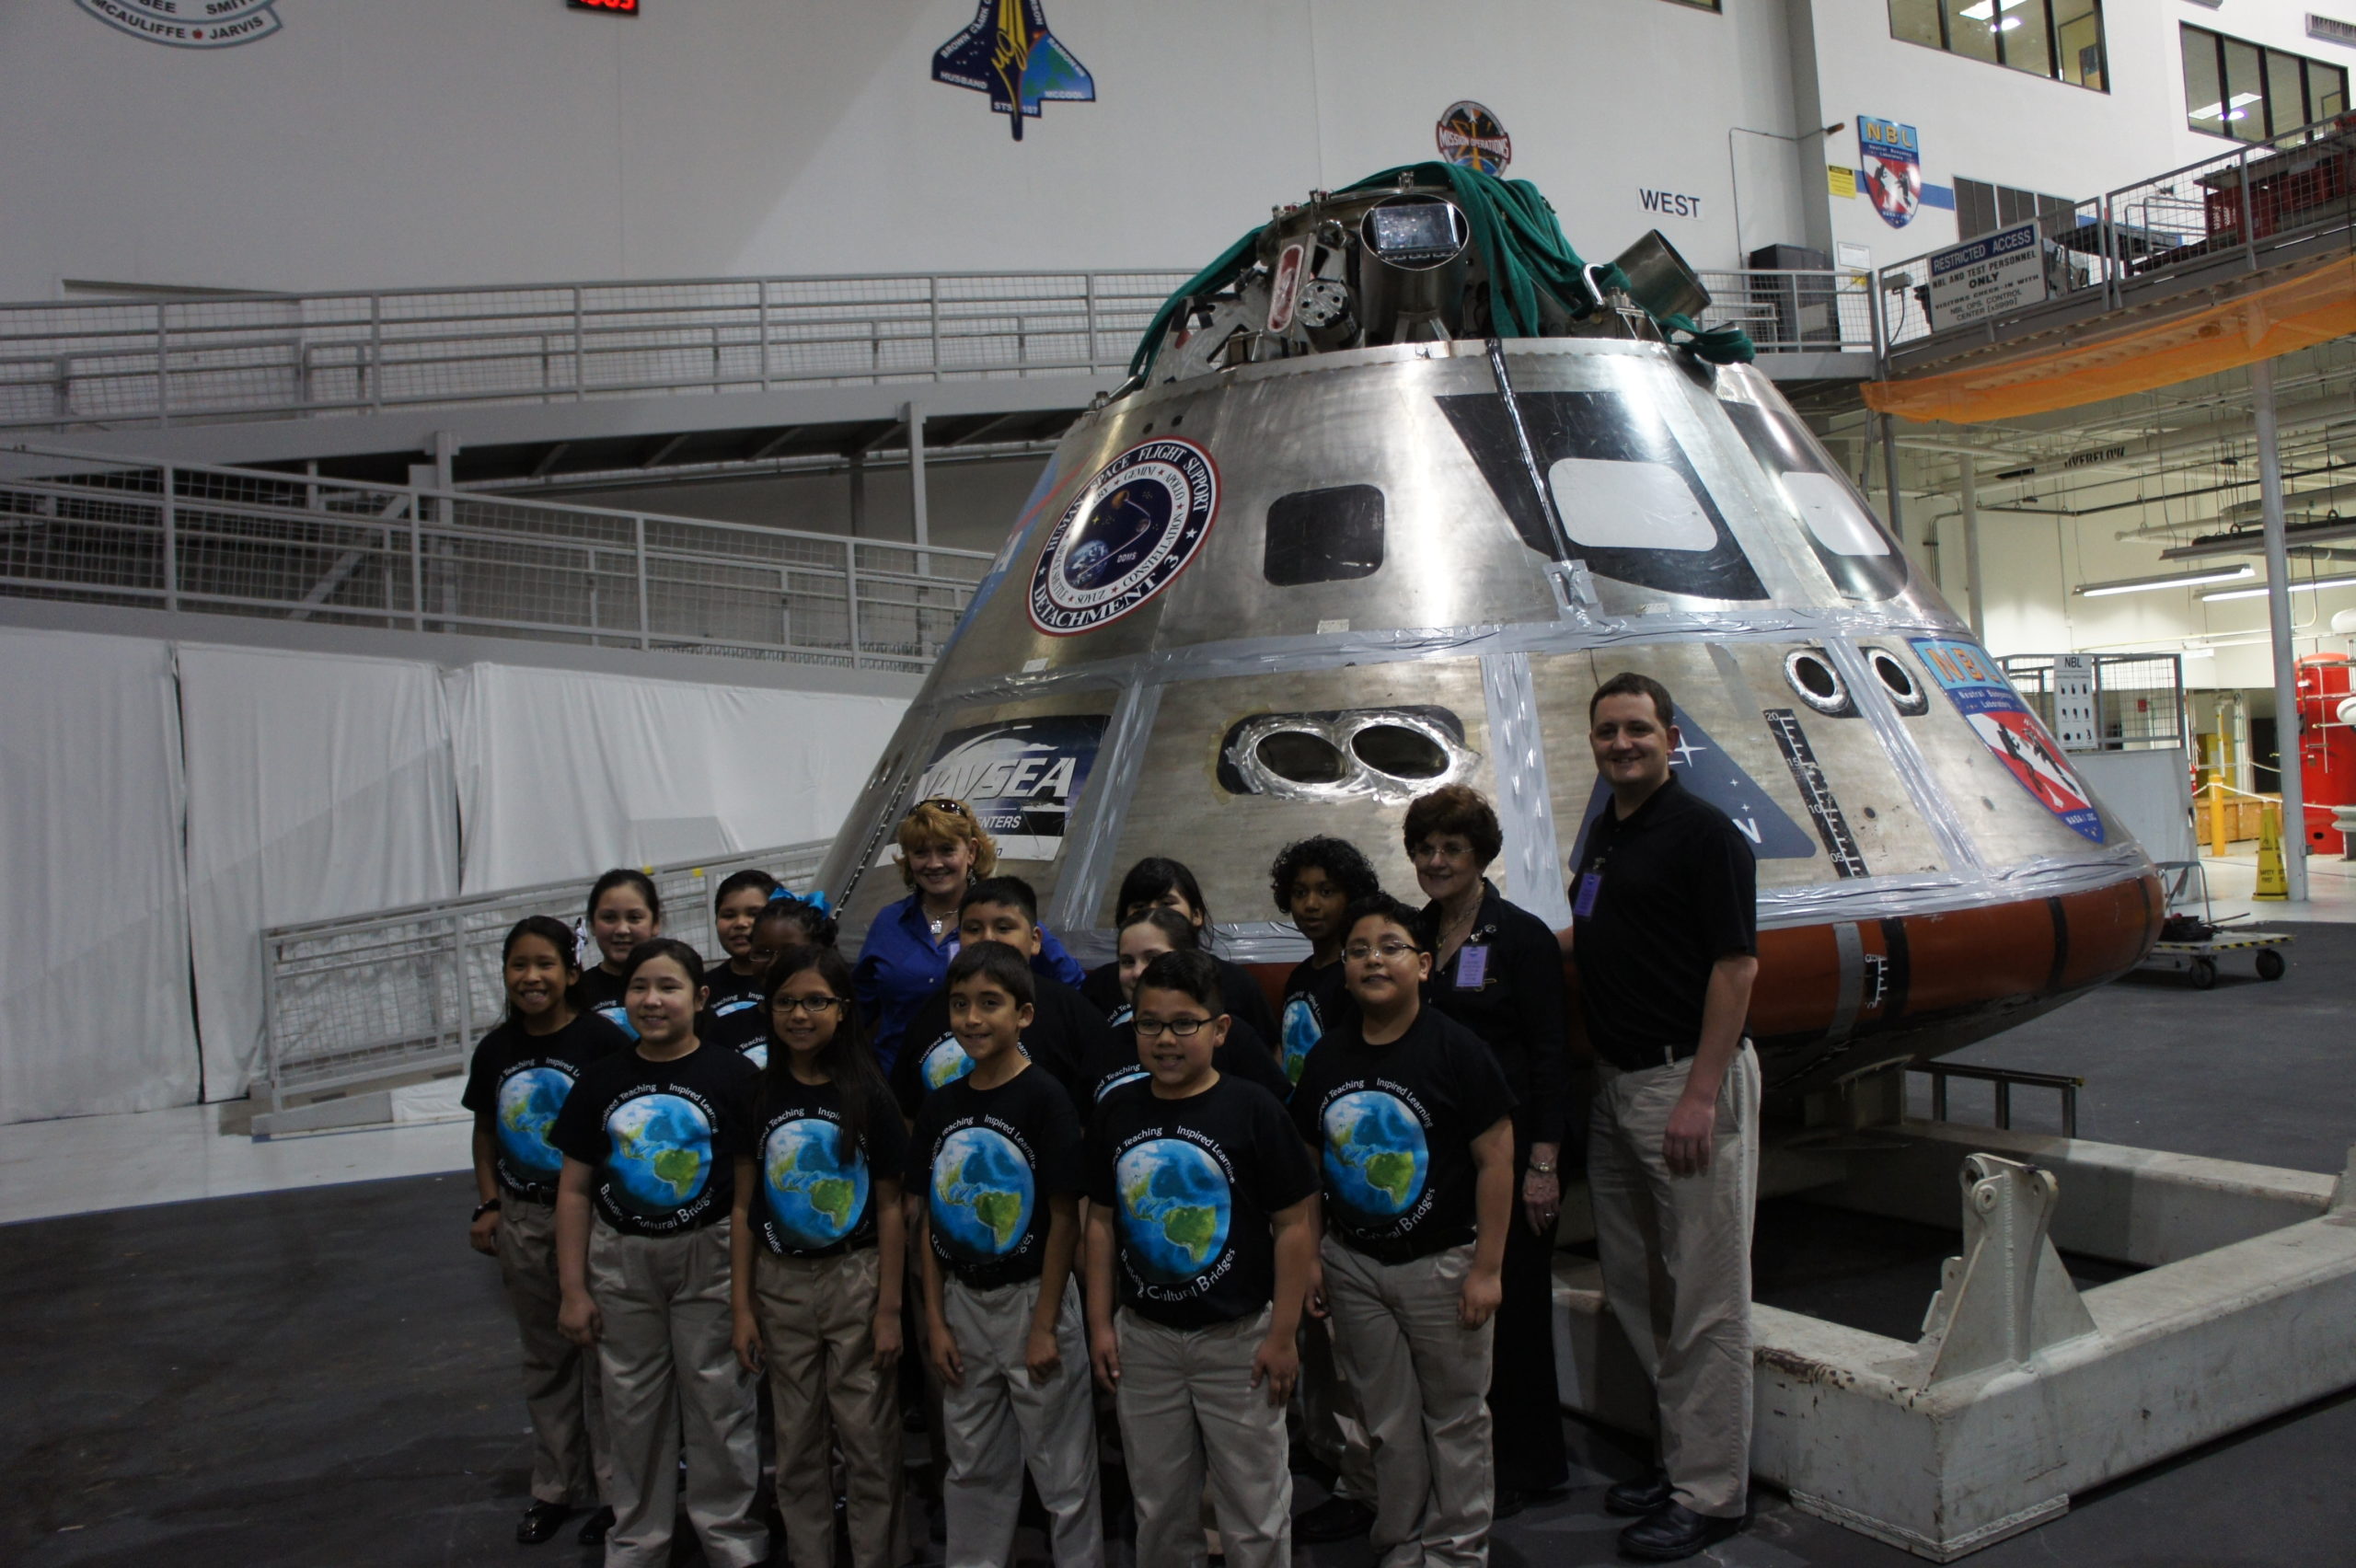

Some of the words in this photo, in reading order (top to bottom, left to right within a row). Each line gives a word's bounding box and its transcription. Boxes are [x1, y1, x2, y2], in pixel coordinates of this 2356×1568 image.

[206, 0, 255, 15] SMIT
[91, 0, 186, 39] MCAULIFFE
[209, 16, 264, 40] JARVIS
[940, 33, 971, 58] BROWN
[969, 6, 989, 34] CLARK
[940, 72, 988, 89] HUSBAND
[994, 101, 1013, 111] STS
[1438, 125, 1469, 150] MISSION
[1470, 138, 1509, 159] OPERATIONS
[1866, 121, 1912, 148] NBL
[1640, 188, 1701, 218] WEST
[1934, 244, 1986, 272] RESTRICTED
[1992, 229, 2032, 253] ACCESS
[1933, 278, 1946, 289] NBL
[1949, 272, 1965, 283] AND
[1968, 265, 1986, 278] TEST
[1989, 250, 2037, 271] PERSONNEL
[1969, 272, 2000, 289] ONLY
[1935, 295, 1970, 309] VISITORS
[2017, 274, 2039, 285] WITH
[1986, 289, 2023, 305] CONTROL
[1957, 307, 1985, 321] CENTER
[1124, 466, 1156, 482] GEMINI
[1164, 472, 1185, 502] APOLLO
[1046, 498, 1084, 552] HUMAN
[1090, 455, 1131, 492] SPACE
[1138, 444, 1188, 463] FLIGHT
[1183, 456, 1211, 513] SUPPORT
[1122, 512, 1184, 588] CONSTELLATION
[1034, 572, 1157, 628] DETACHMENT
[1163, 554, 1180, 570] 3
[1075, 590, 1106, 605] SOYUZ
[1925, 647, 2002, 684] NBL
[2064, 657, 2082, 668] NBL
[1958, 689, 1986, 699] Neutral
[1981, 699, 2013, 709] Laboratory
[1765, 711, 1780, 721] 20
[1787, 757, 1800, 767] 15
[914, 757, 1077, 801] NAVSEA
[1808, 803, 1822, 814] 10
[2065, 813, 2083, 825] NASA
[1830, 852, 1845, 862] 05
[739, 1035, 767, 1050] Teachi
[545, 1056, 574, 1073] Inspired
[1106, 1063, 1141, 1082] Teaching
[618, 1083, 658, 1101] Teaching
[669, 1082, 702, 1102] Inspired
[1328, 1078, 1366, 1098] Teaching
[1376, 1077, 1409, 1097] Inspired
[1405, 1091, 1435, 1128] Learning
[768, 1107, 805, 1127] Teaching
[818, 1107, 840, 1122] Inspi
[984, 1114, 1014, 1136] Inspired
[1123, 1126, 1163, 1147] Teaching
[1176, 1124, 1215, 1147] Inspired
[1398, 1187, 1436, 1232] Bridges
[1196, 1248, 1236, 1293] Bridges
